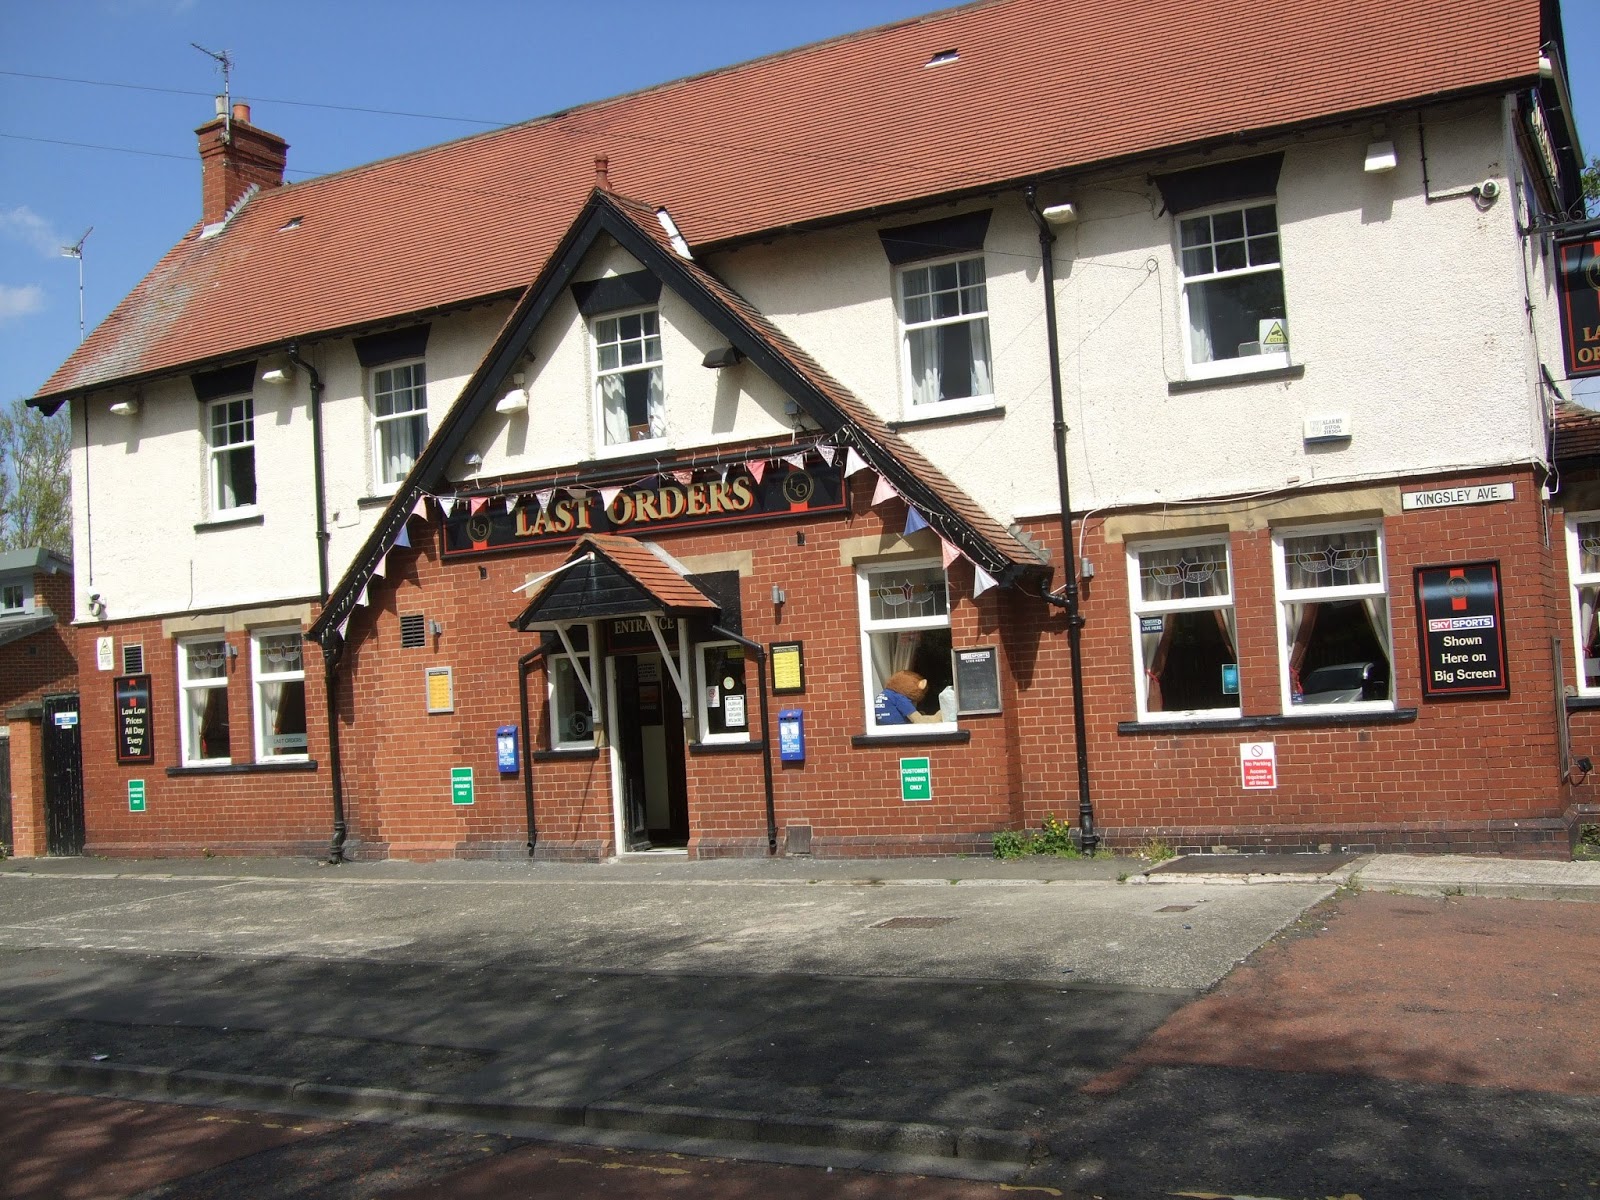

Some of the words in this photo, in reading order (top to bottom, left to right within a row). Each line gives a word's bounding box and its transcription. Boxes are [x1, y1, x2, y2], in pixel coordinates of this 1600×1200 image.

[1415, 489, 1471, 506] KINGSLEY
[1477, 486, 1501, 499] AVE.
[515, 496, 595, 537] LAST
[606, 476, 753, 525] ORDERS
[614, 616, 675, 634] ENTRACE
[1431, 621, 1450, 630] SKY
[1452, 617, 1491, 628] SPORTS
[1443, 636, 1483, 647] Shown
[1441, 653, 1469, 664] Here
[1471, 653, 1487, 662] on
[1434, 670, 1454, 683] Big
[1456, 669, 1497, 680] Screen
[133, 727, 144, 735] Day
[127, 737, 142, 745] Every
[130, 747, 141, 755] Day
